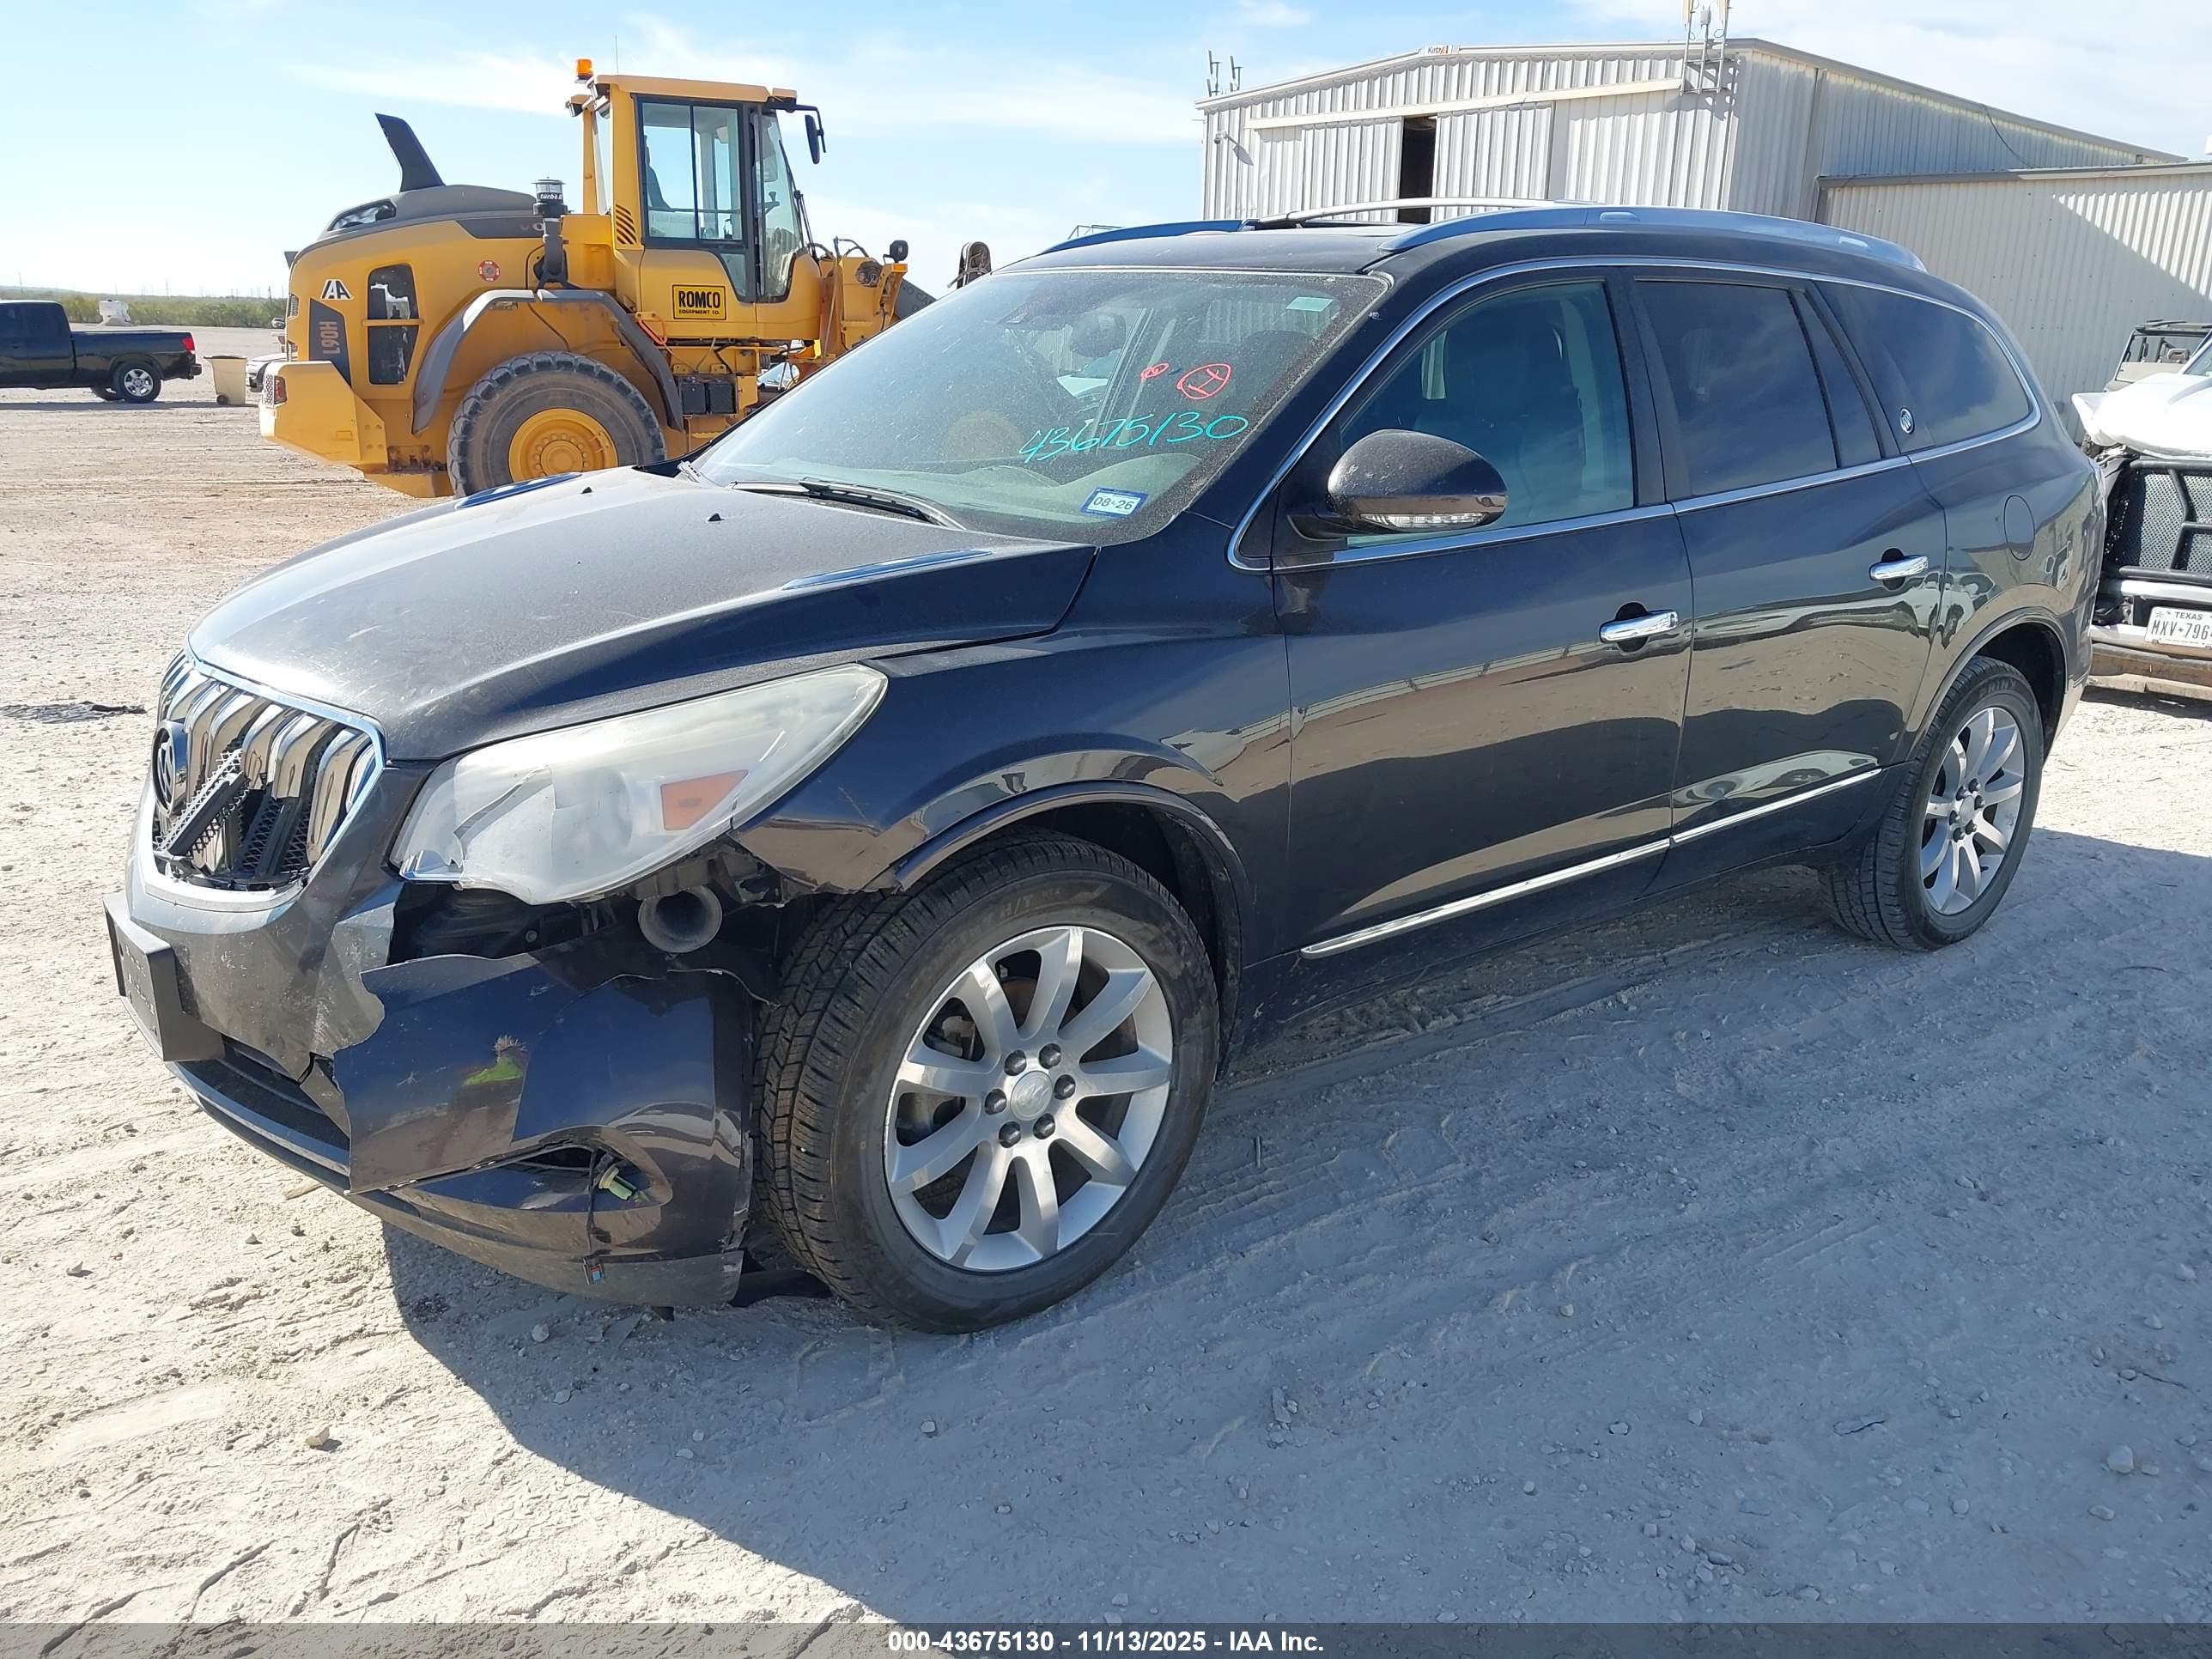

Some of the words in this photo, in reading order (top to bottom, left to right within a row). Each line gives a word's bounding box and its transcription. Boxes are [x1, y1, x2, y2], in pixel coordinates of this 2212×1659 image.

[678, 291, 720, 308] ROMCO
[319, 321, 341, 355] L90H
[1018, 412, 1249, 464] 43675130
[2175, 611, 2203, 620] TEXAS
[2185, 623, 2212, 640] 796
